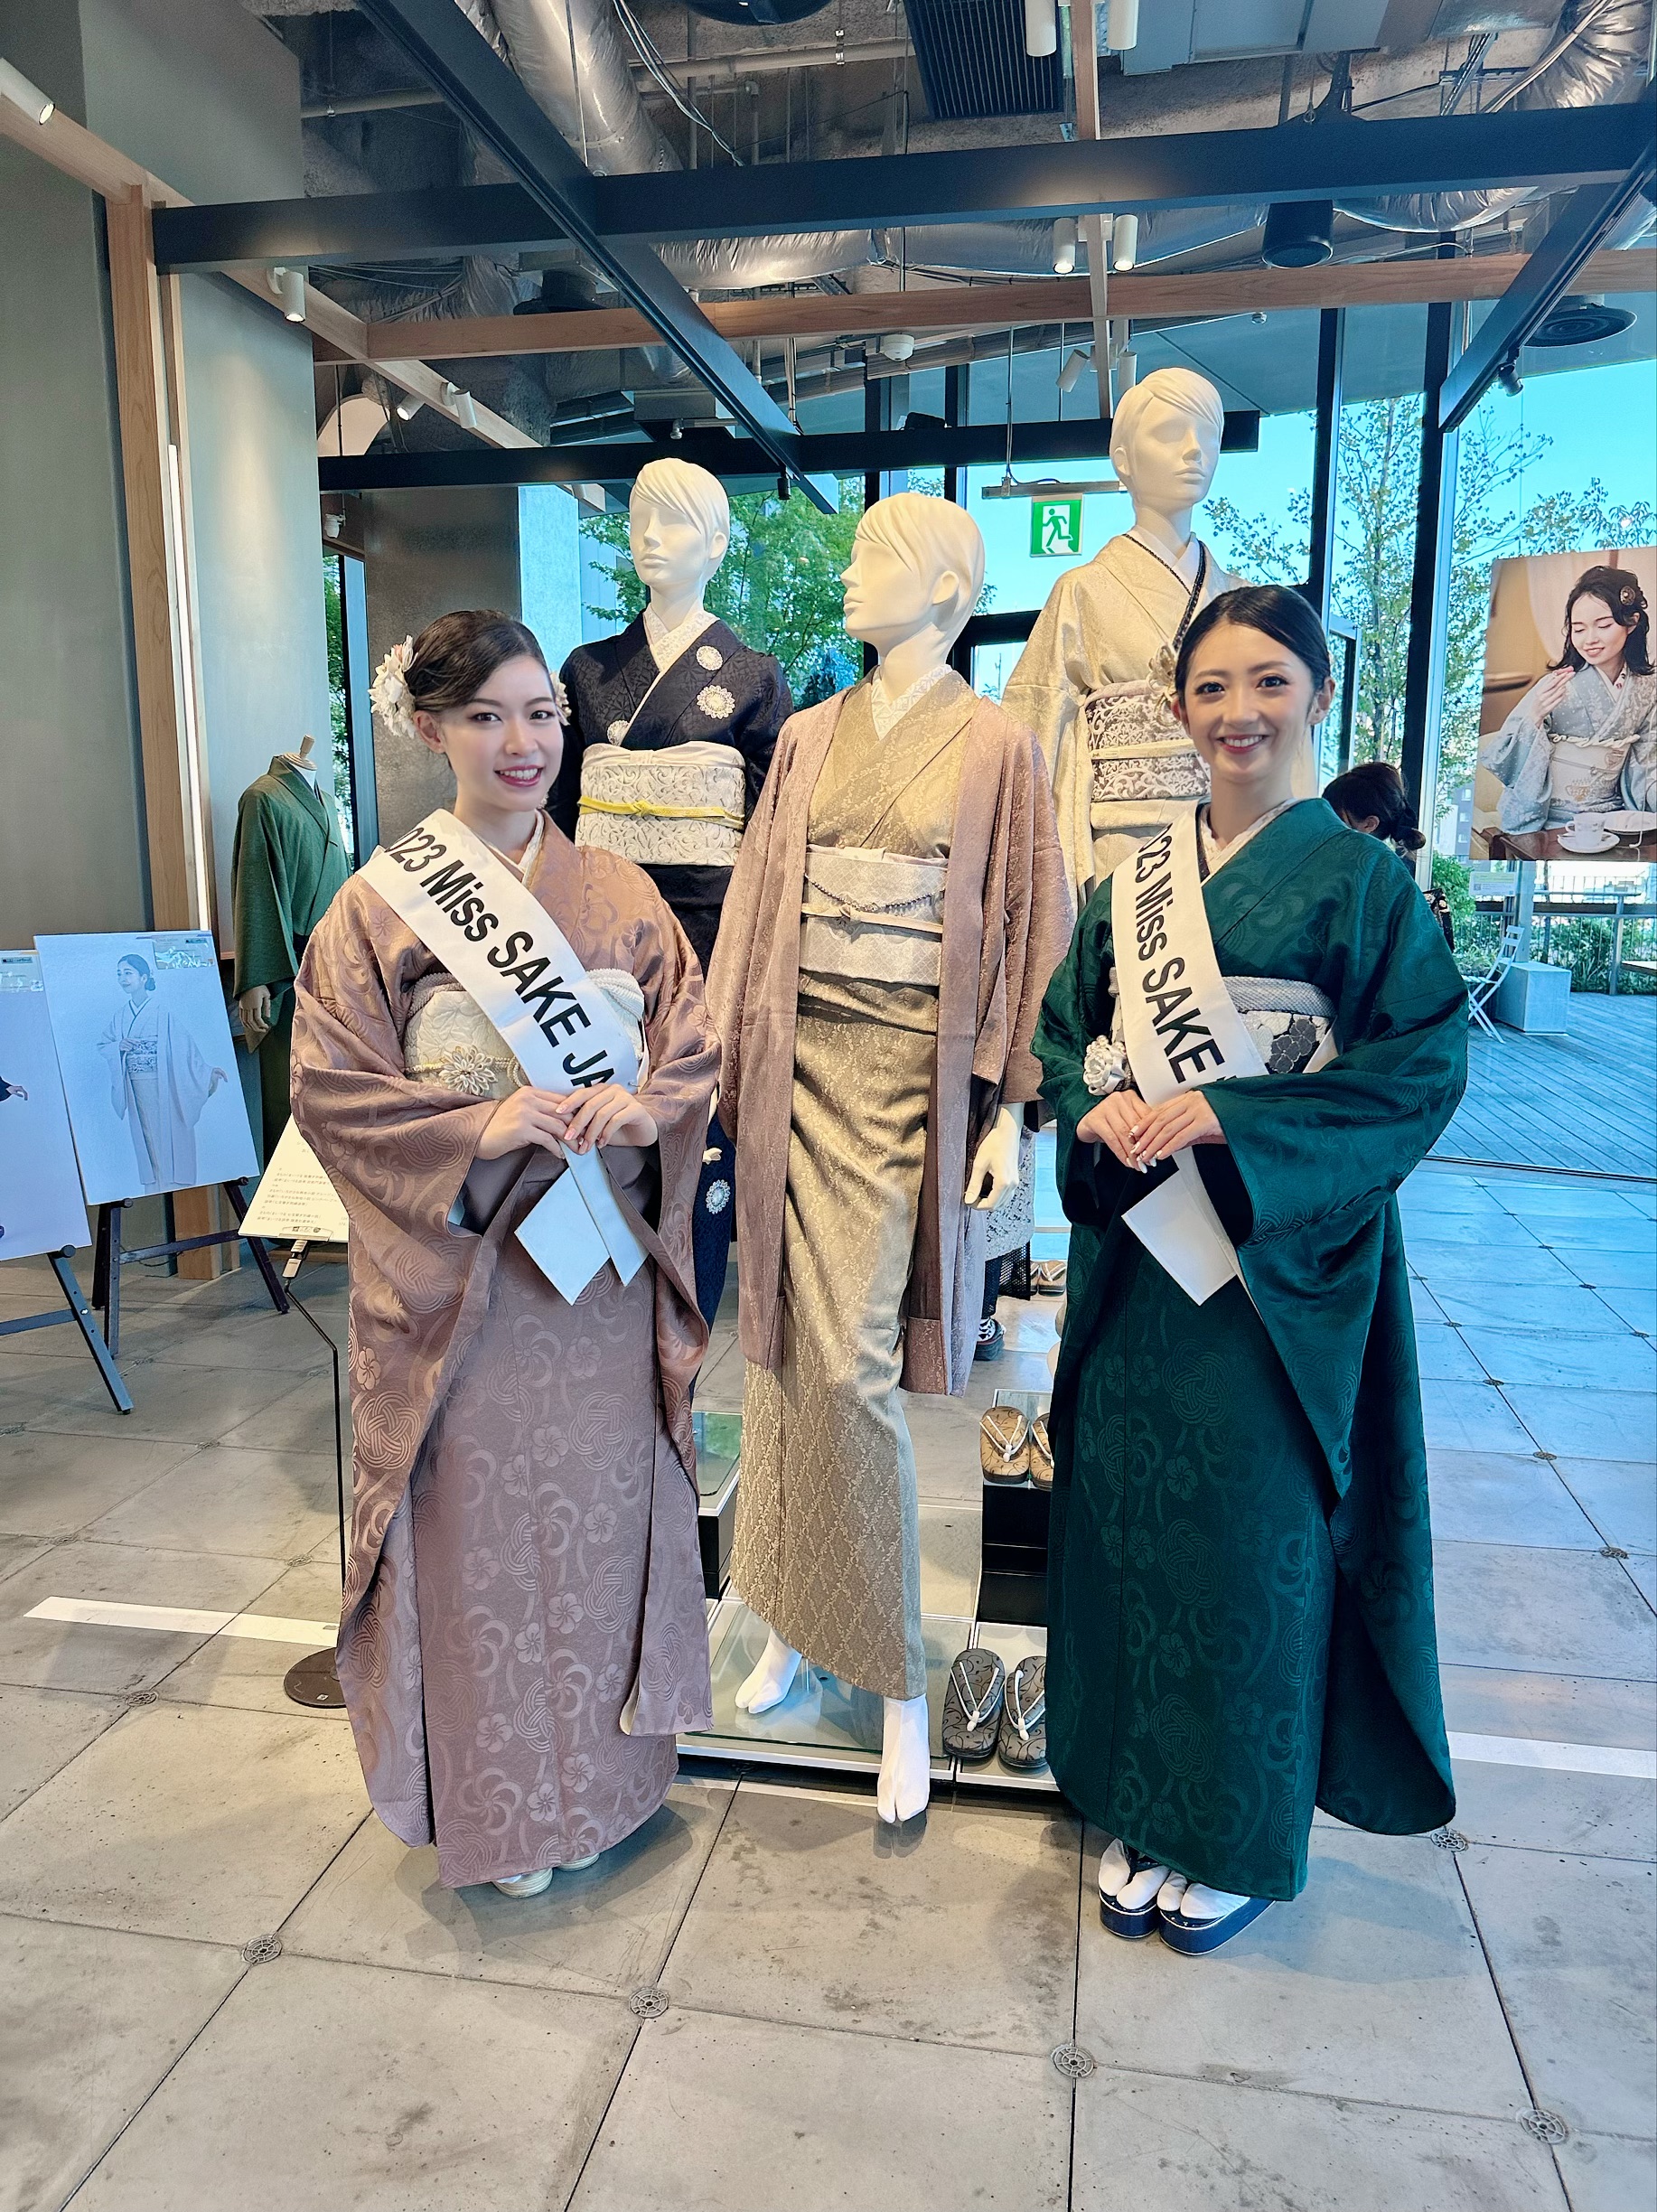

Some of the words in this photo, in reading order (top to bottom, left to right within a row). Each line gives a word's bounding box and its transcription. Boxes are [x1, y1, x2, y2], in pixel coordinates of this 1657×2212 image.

[419, 859, 499, 942] Miss
[487, 932, 592, 1048] SAKE
[1136, 872, 1174, 961] Miss
[1143, 958, 1226, 1083] SAKE
